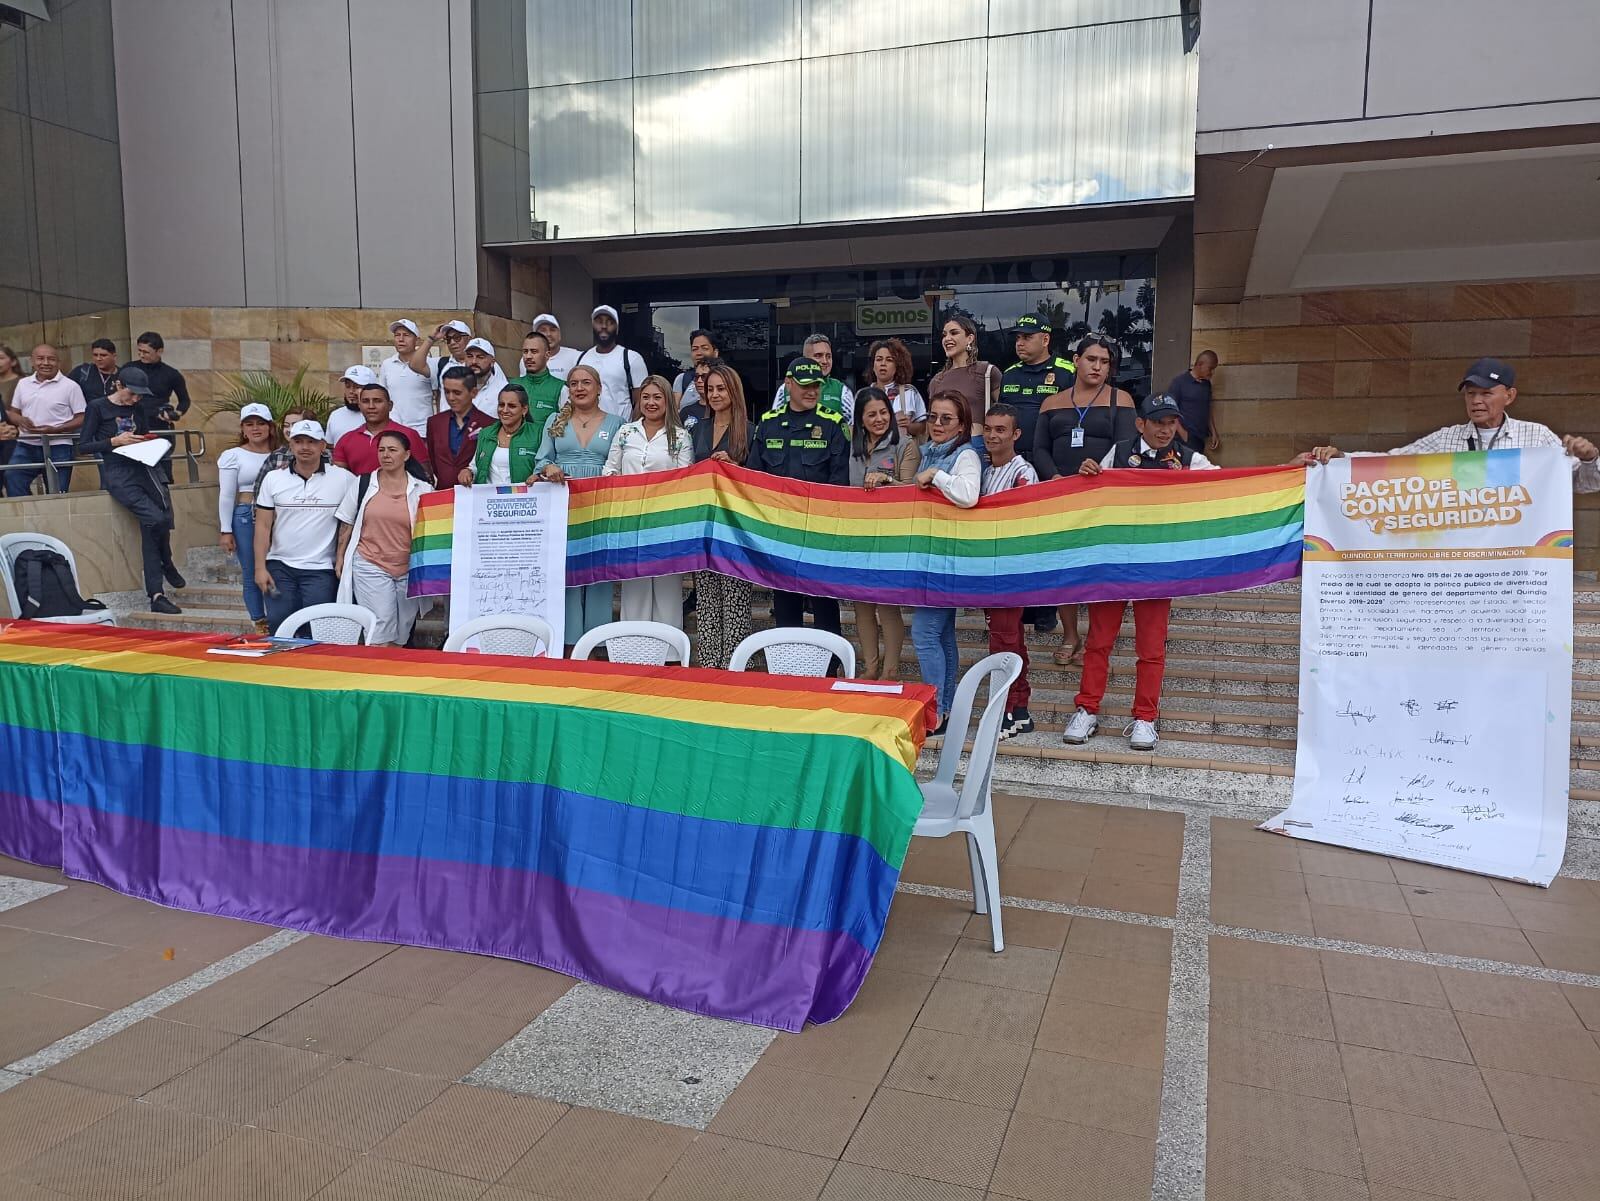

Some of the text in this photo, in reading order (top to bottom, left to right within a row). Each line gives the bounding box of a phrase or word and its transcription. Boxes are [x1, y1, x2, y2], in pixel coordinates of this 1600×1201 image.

[861, 307, 929, 324] Somos
[1340, 476, 1452, 500] PACTO DE
[487, 501, 537, 510] CONVIVENCIA
[1341, 485, 1527, 517] CONVIVENCIA
[493, 510, 537, 518] SEGURIDAD
[1365, 506, 1518, 533] Y SEGURIDAD
